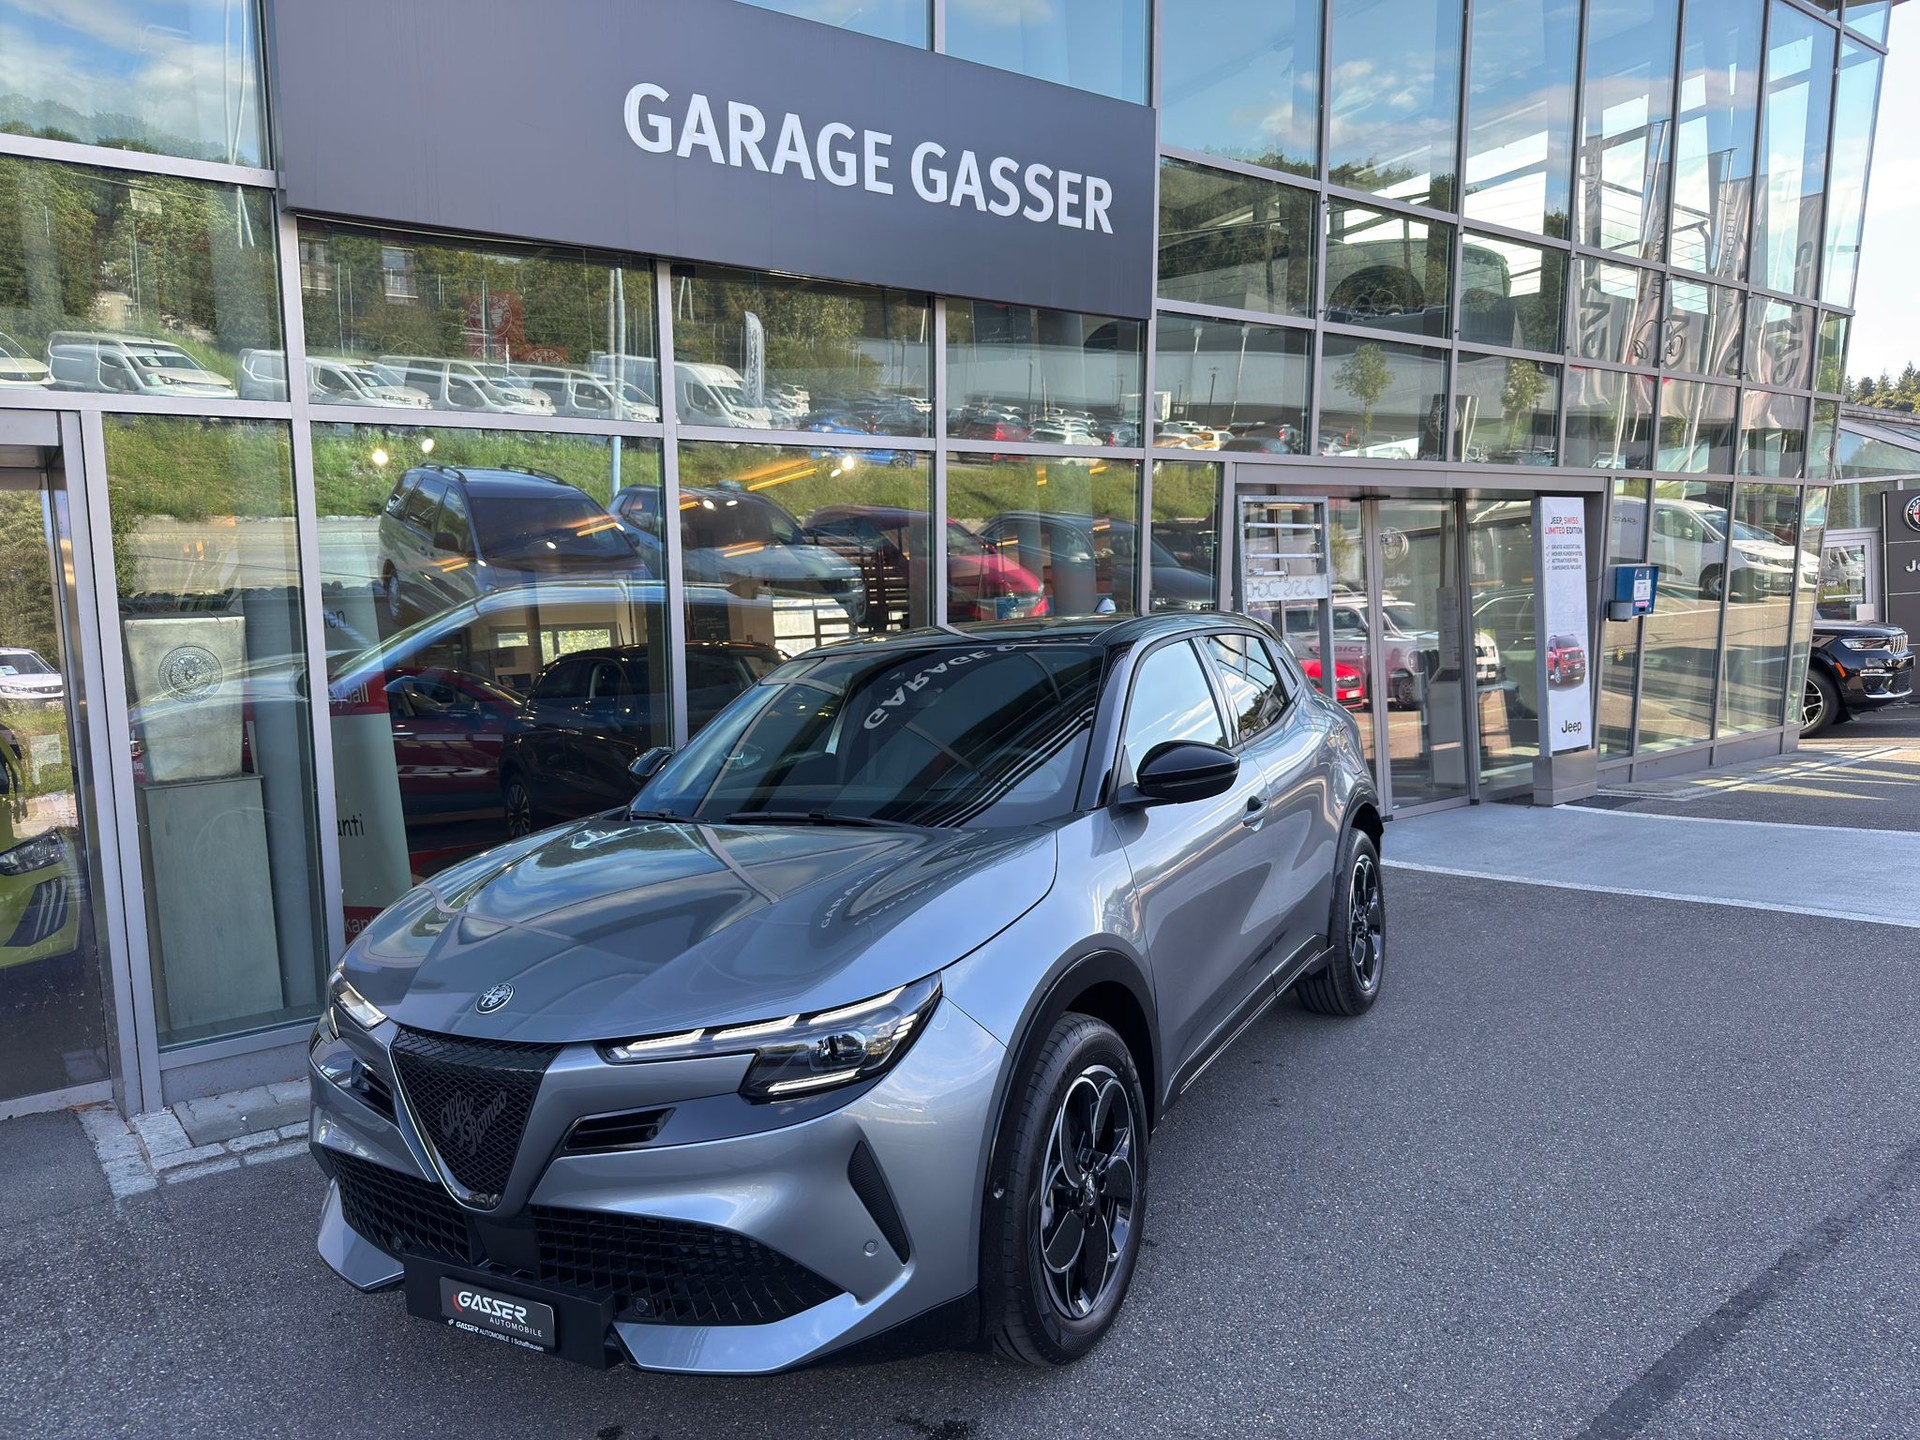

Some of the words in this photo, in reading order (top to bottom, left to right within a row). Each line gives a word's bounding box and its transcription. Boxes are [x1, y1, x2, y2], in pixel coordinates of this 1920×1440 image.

[623, 82, 894, 196] GARAGE
[910, 141, 1114, 235] GASSER
[1545, 526, 1566, 535] LIMITED
[1566, 526, 1583, 535] EDITION
[1563, 516, 1579, 525] SWISS
[1561, 719, 1583, 735] Jeep
[457, 1290, 527, 1325] GASSER
[455, 1320, 479, 1334] GASSER
[479, 1327, 510, 1344] AUTOMOBILE
[489, 1316, 543, 1338] AUTOMOBILE
